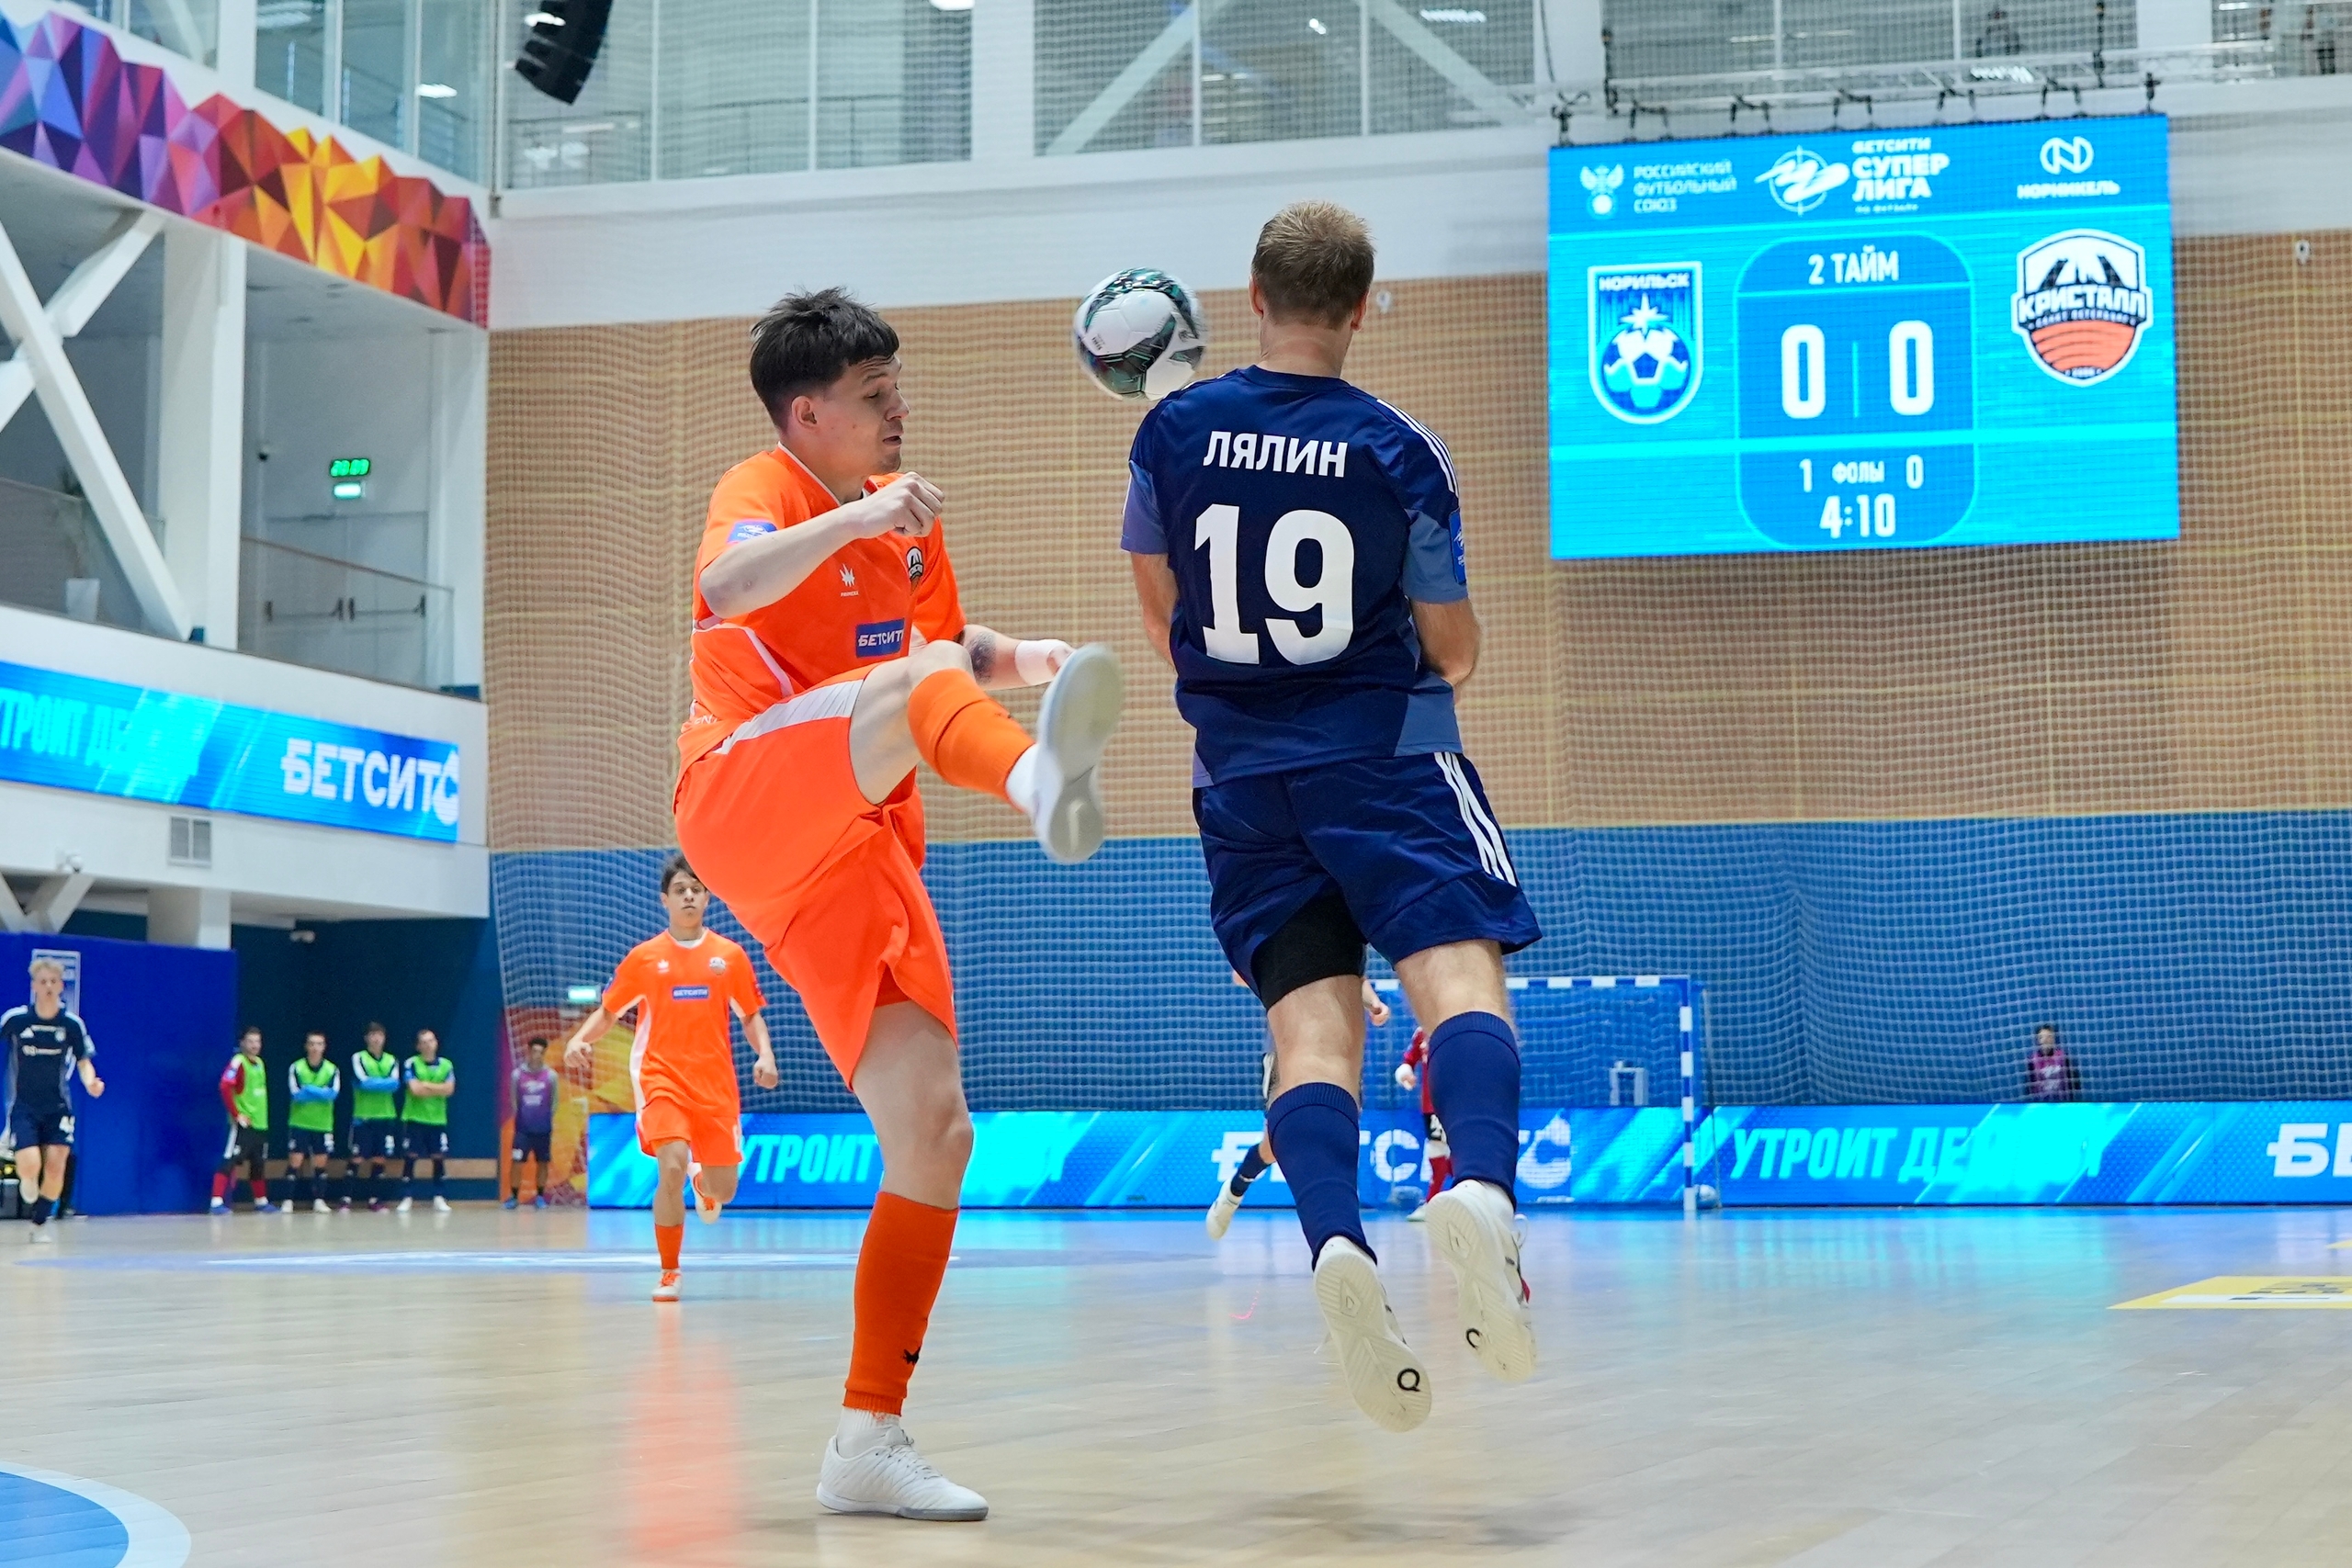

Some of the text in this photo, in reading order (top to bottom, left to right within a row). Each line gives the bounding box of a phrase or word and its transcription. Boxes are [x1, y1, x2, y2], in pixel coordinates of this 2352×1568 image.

[1852, 137, 1931, 154] БЕТСИТИ
[1634, 161, 1732, 179] РОССИЙСКИЙ
[1852, 153, 1950, 179] СУПЕР
[1634, 176, 1737, 196] ФУТБОЛЬНЫЙ
[1852, 177, 1932, 201] ЛИГА
[2018, 181, 2120, 198] НОРНИКЕЛЬ
[1634, 197, 1677, 213] СОЮЗ
[1808, 244, 1899, 285] 2 ТАЙМ
[1599, 273, 1690, 291] НОРИЛЬСК
[2018, 286, 2146, 323] КРИСТАЛЛ
[1781, 320, 1935, 419] 0 0
[1203, 430, 1348, 478] ЛЯЛИН
[1799, 454, 1924, 493] 1 ФОЛЫ 0
[1819, 493, 1896, 539] 4:10
[1194, 503, 1355, 667] 19
[1730, 1126, 1898, 1180] УТРОИТ
